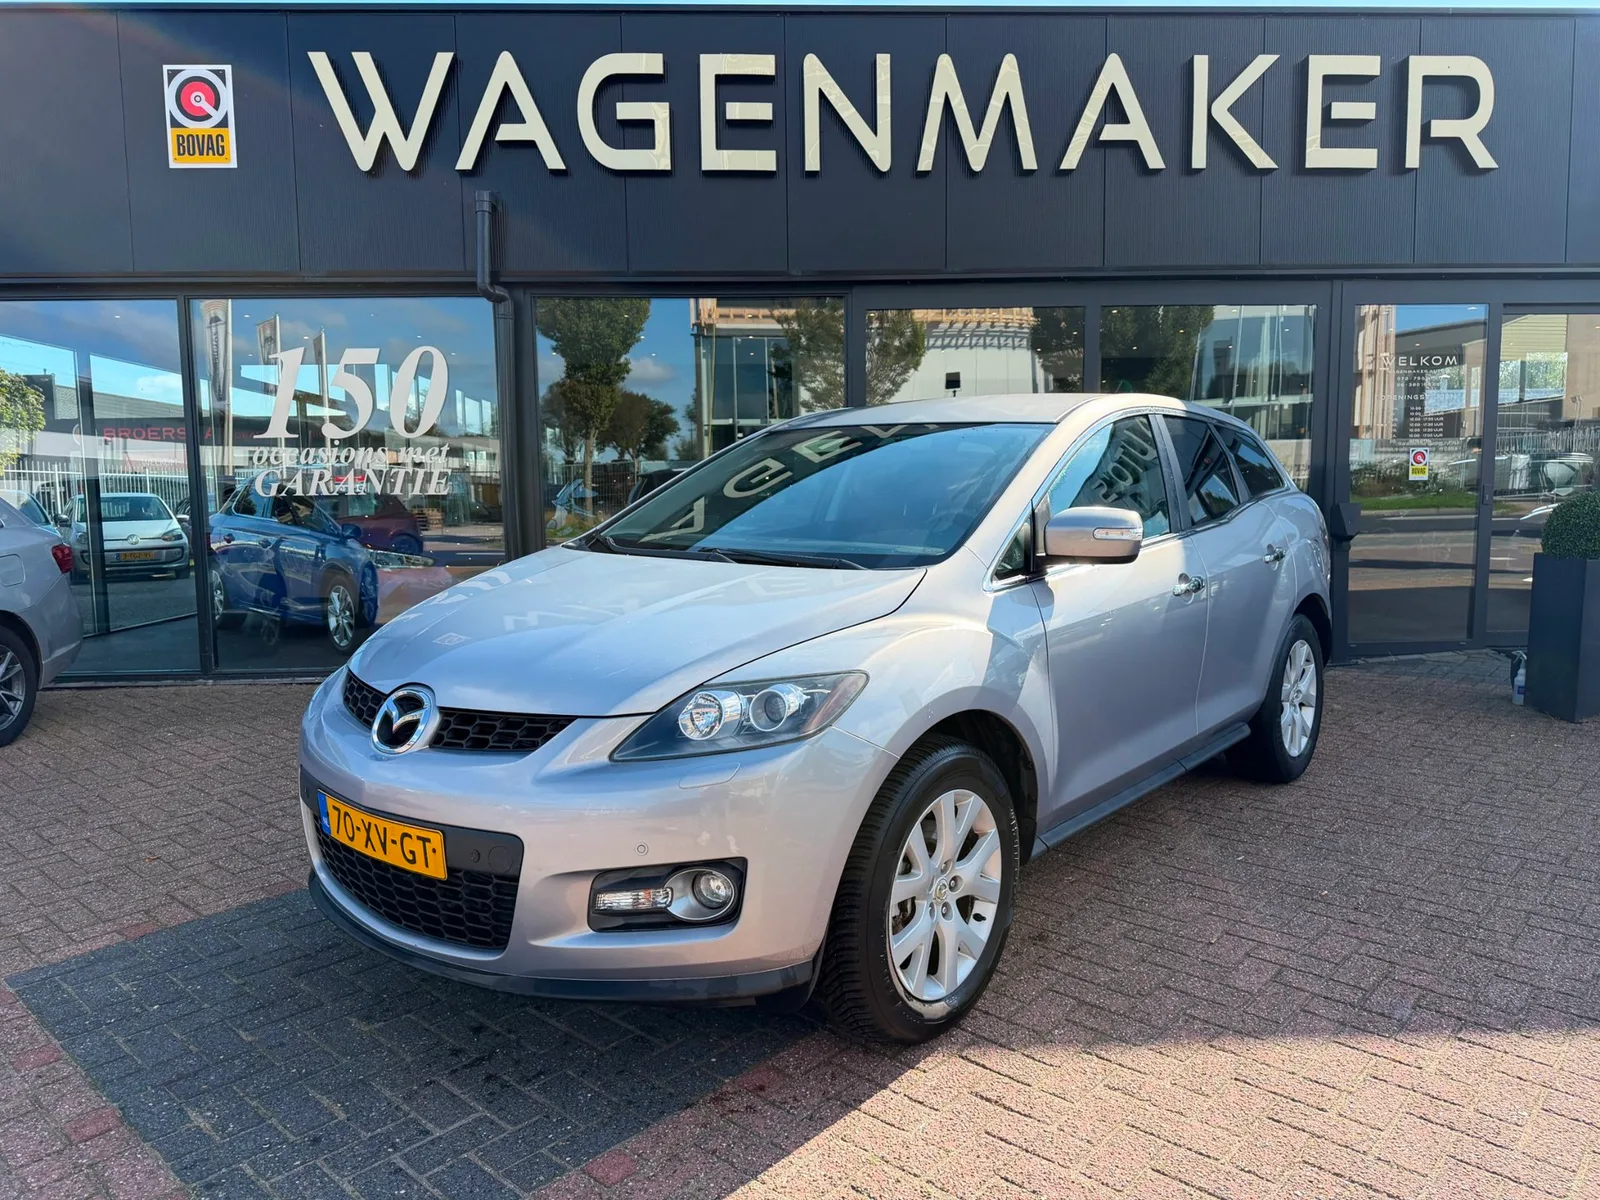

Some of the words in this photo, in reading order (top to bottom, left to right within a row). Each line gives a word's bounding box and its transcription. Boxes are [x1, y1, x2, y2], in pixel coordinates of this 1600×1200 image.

[307, 50, 1499, 173] WAGENMAKER
[176, 133, 226, 156] BOVAG
[1382, 355, 1458, 367] WELKOM
[253, 345, 449, 439] 150
[103, 427, 186, 441] BROERS
[252, 439, 389, 465] occasions
[399, 442, 451, 464] met
[254, 467, 453, 498] GARANTIE
[1411, 467, 1427, 476] BOVAG
[332, 804, 432, 869] 70-XV-GT
